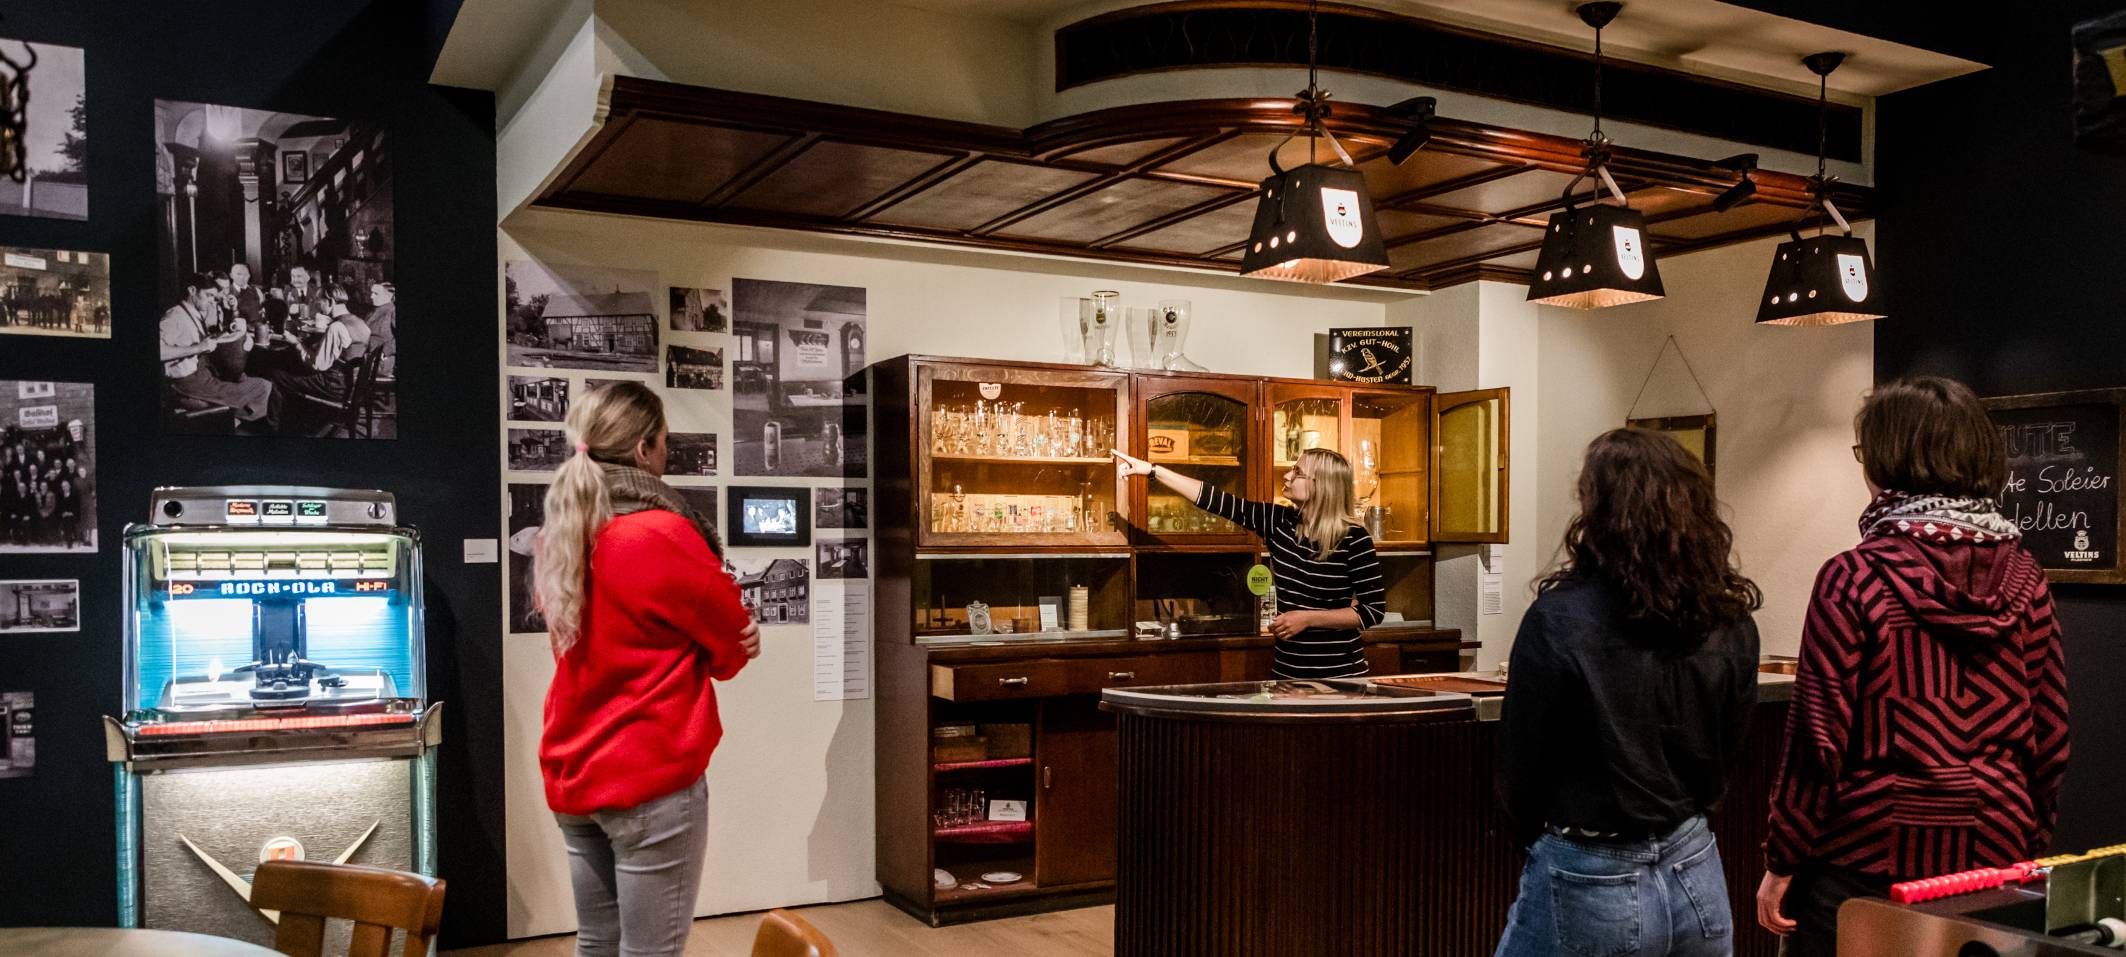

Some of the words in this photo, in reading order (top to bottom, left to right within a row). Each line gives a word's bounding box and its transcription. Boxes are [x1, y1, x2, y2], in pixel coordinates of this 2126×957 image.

[2000, 421, 2077, 458] UTE
[2038, 465, 2111, 494] Soleier
[2064, 551, 2100, 559] VELTINS
